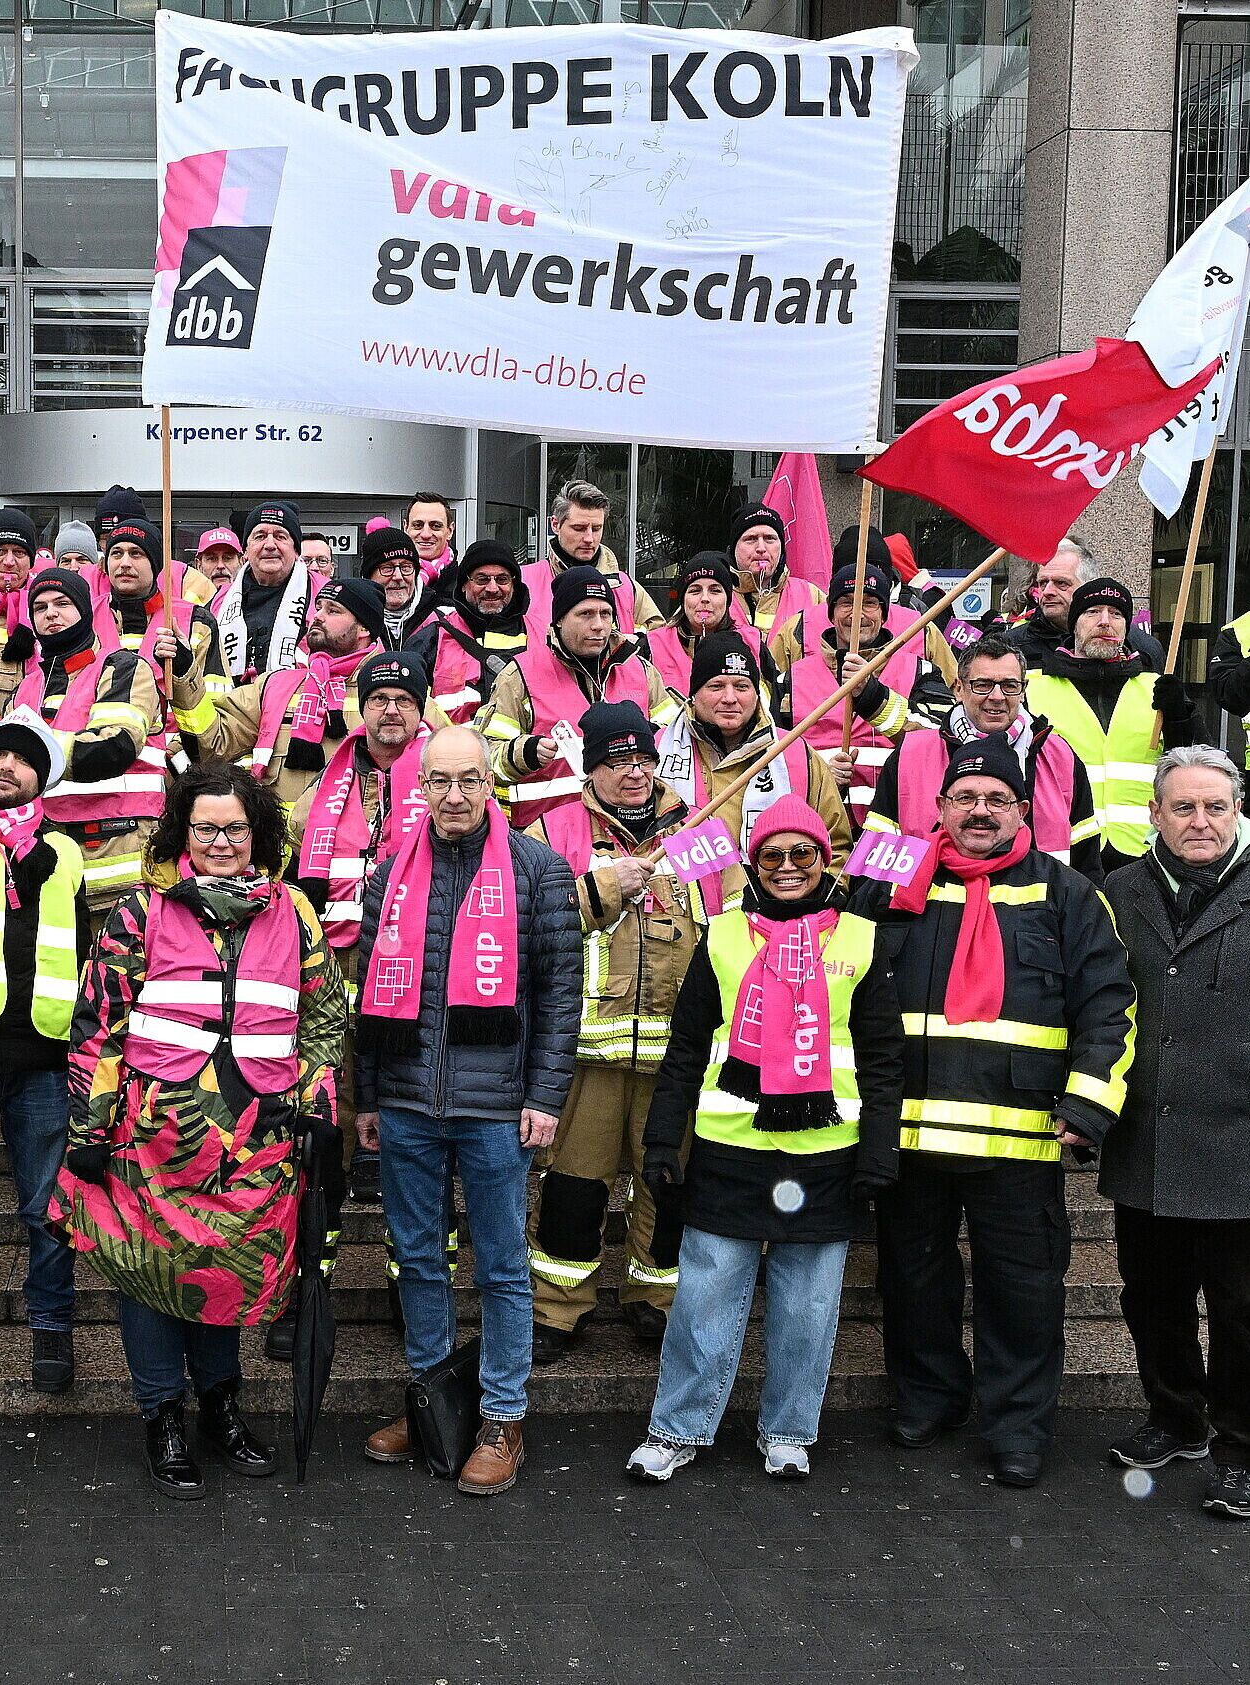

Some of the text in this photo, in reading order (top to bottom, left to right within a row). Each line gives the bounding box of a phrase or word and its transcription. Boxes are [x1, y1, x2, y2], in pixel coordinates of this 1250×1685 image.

[176, 47, 612, 136] FAGRUPPE
[371, 237, 858, 324] gewerkschaft
[174, 295, 244, 341] dbb
[361, 339, 647, 396] www.vdla-dbb.de
[255, 424, 291, 441] Str.
[298, 425, 323, 442] 62
[208, 531, 232, 541] dbb
[324, 766, 354, 815] dbb
[672, 835, 735, 872] vdla
[864, 840, 915, 875] dbb
[477, 932, 504, 996] dbb
[794, 1002, 820, 1077] dbb
